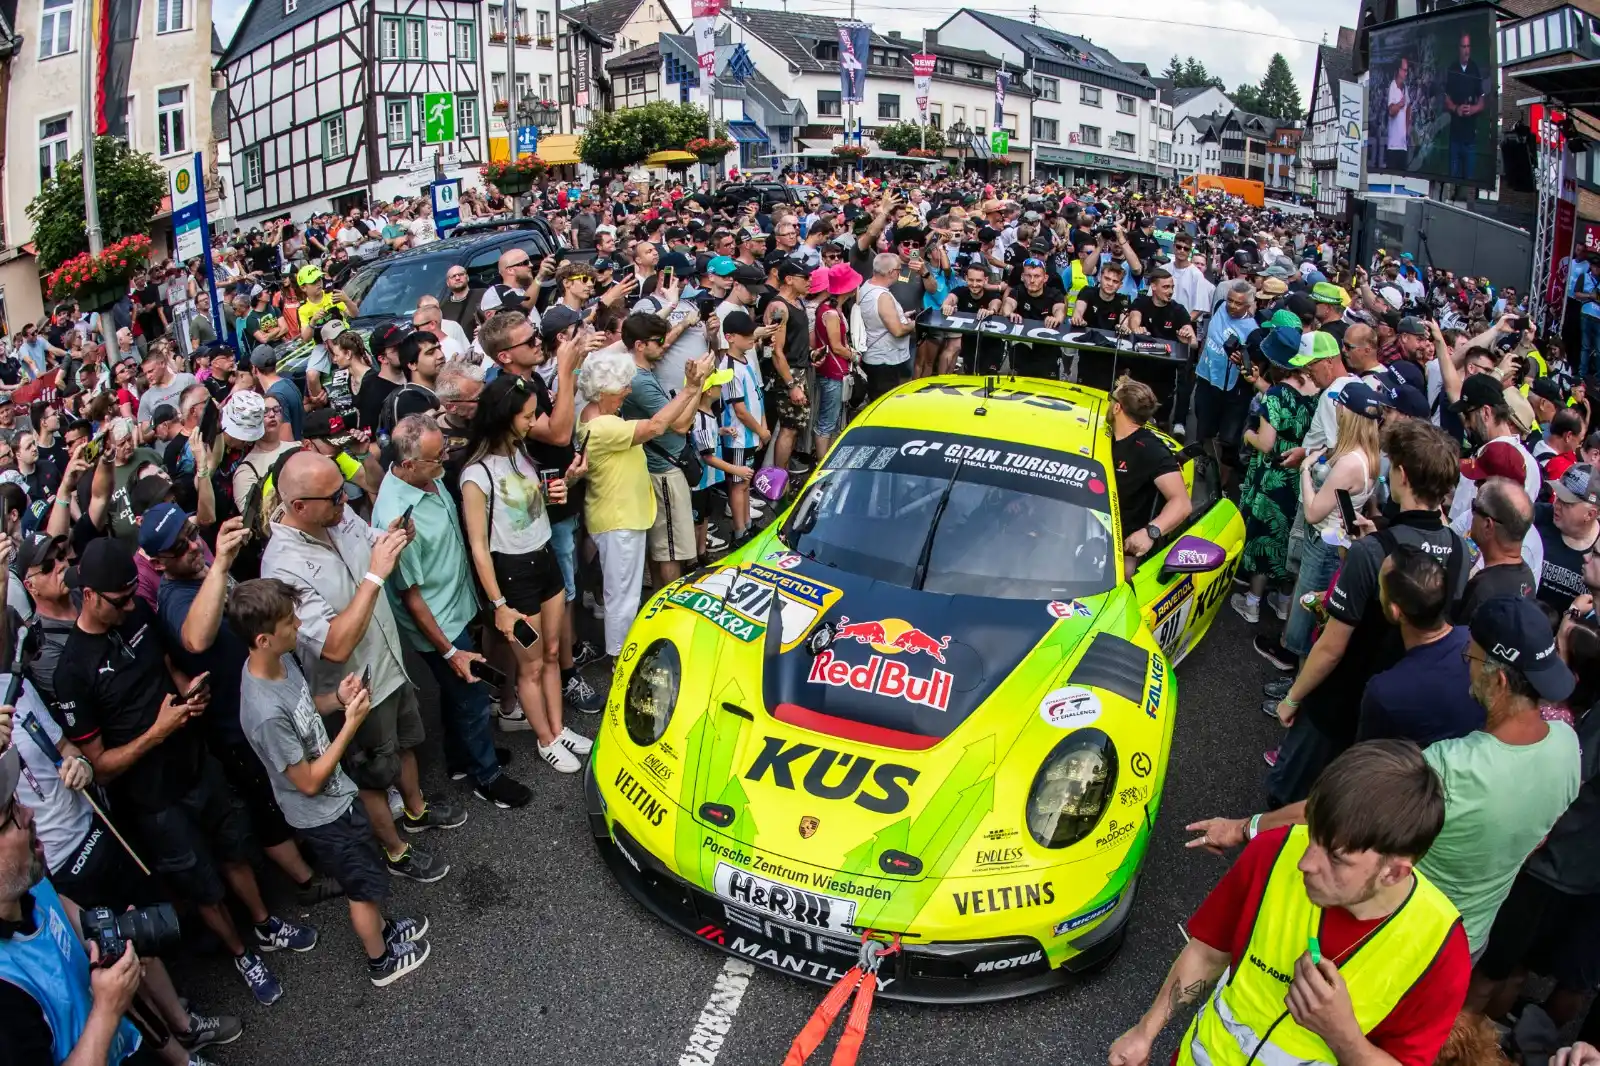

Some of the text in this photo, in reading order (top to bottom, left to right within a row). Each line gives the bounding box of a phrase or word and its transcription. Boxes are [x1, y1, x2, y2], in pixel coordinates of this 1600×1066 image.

[576, 52, 589, 91] Museum
[914, 58, 936, 66] REWE
[1340, 94, 1361, 166] FABRY
[1093, 155, 1111, 166] Brück
[943, 456, 1084, 489] THE REAL DRIVING SIMULATOR
[944, 444, 1089, 482] GRAN TURISMO
[1431, 544, 1452, 555] TOTA
[751, 567, 823, 600] RAVENOL
[1157, 582, 1194, 618] RAVENOL
[694, 595, 755, 643] DEKRA
[1159, 607, 1182, 649] 911
[808, 649, 954, 712] Red Bull
[643, 753, 674, 780] ENDLESS
[744, 736, 921, 814] KÜS
[614, 767, 668, 827] VELTINS
[71, 828, 102, 875] DONNAY
[1095, 820, 1135, 848] PADDOCK
[702, 836, 893, 901] Porsche Zentrum Wiesbaden
[976, 847, 1024, 864] ENDLESS
[728, 870, 796, 918] H&R
[953, 881, 1056, 917] VELTINS
[1071, 900, 1117, 928] MICHELIN
[730, 937, 896, 992] MANTHY
[974, 950, 1043, 973] MOTUL
[1249, 954, 1267, 972] MSC
